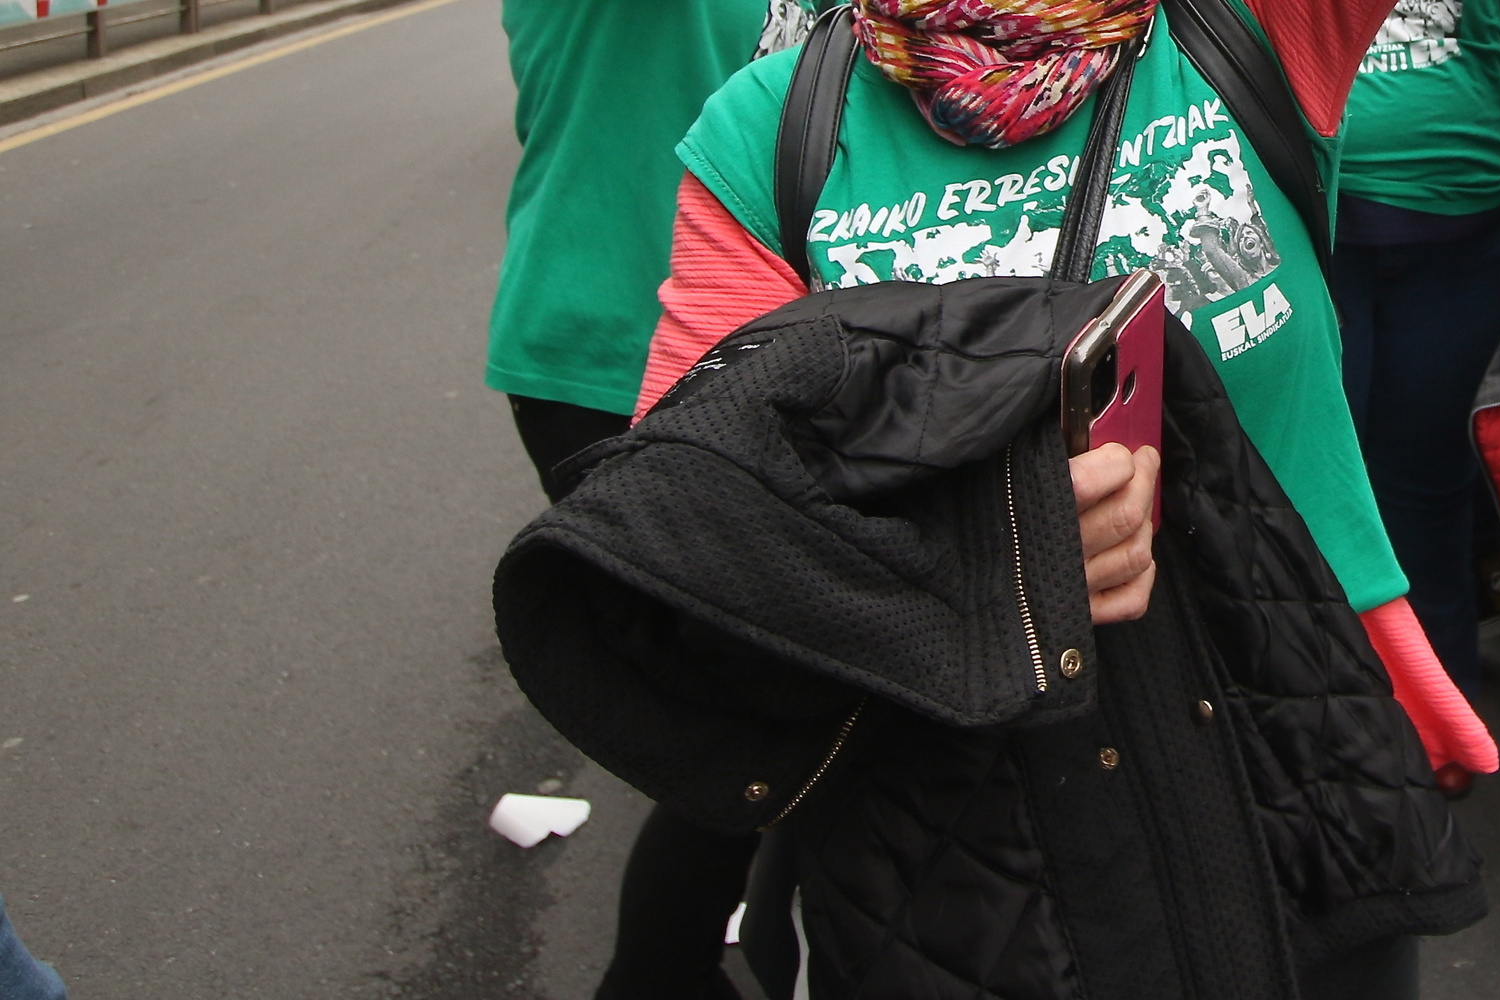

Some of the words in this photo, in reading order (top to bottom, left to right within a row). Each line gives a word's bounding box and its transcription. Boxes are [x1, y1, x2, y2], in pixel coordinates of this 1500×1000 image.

[936, 97, 1229, 221] ERRESINTZIAK
[1210, 282, 1291, 353] ELA
[1221, 339, 1256, 361] EUSKAL
[1256, 307, 1294, 343] SINDIKATUA
